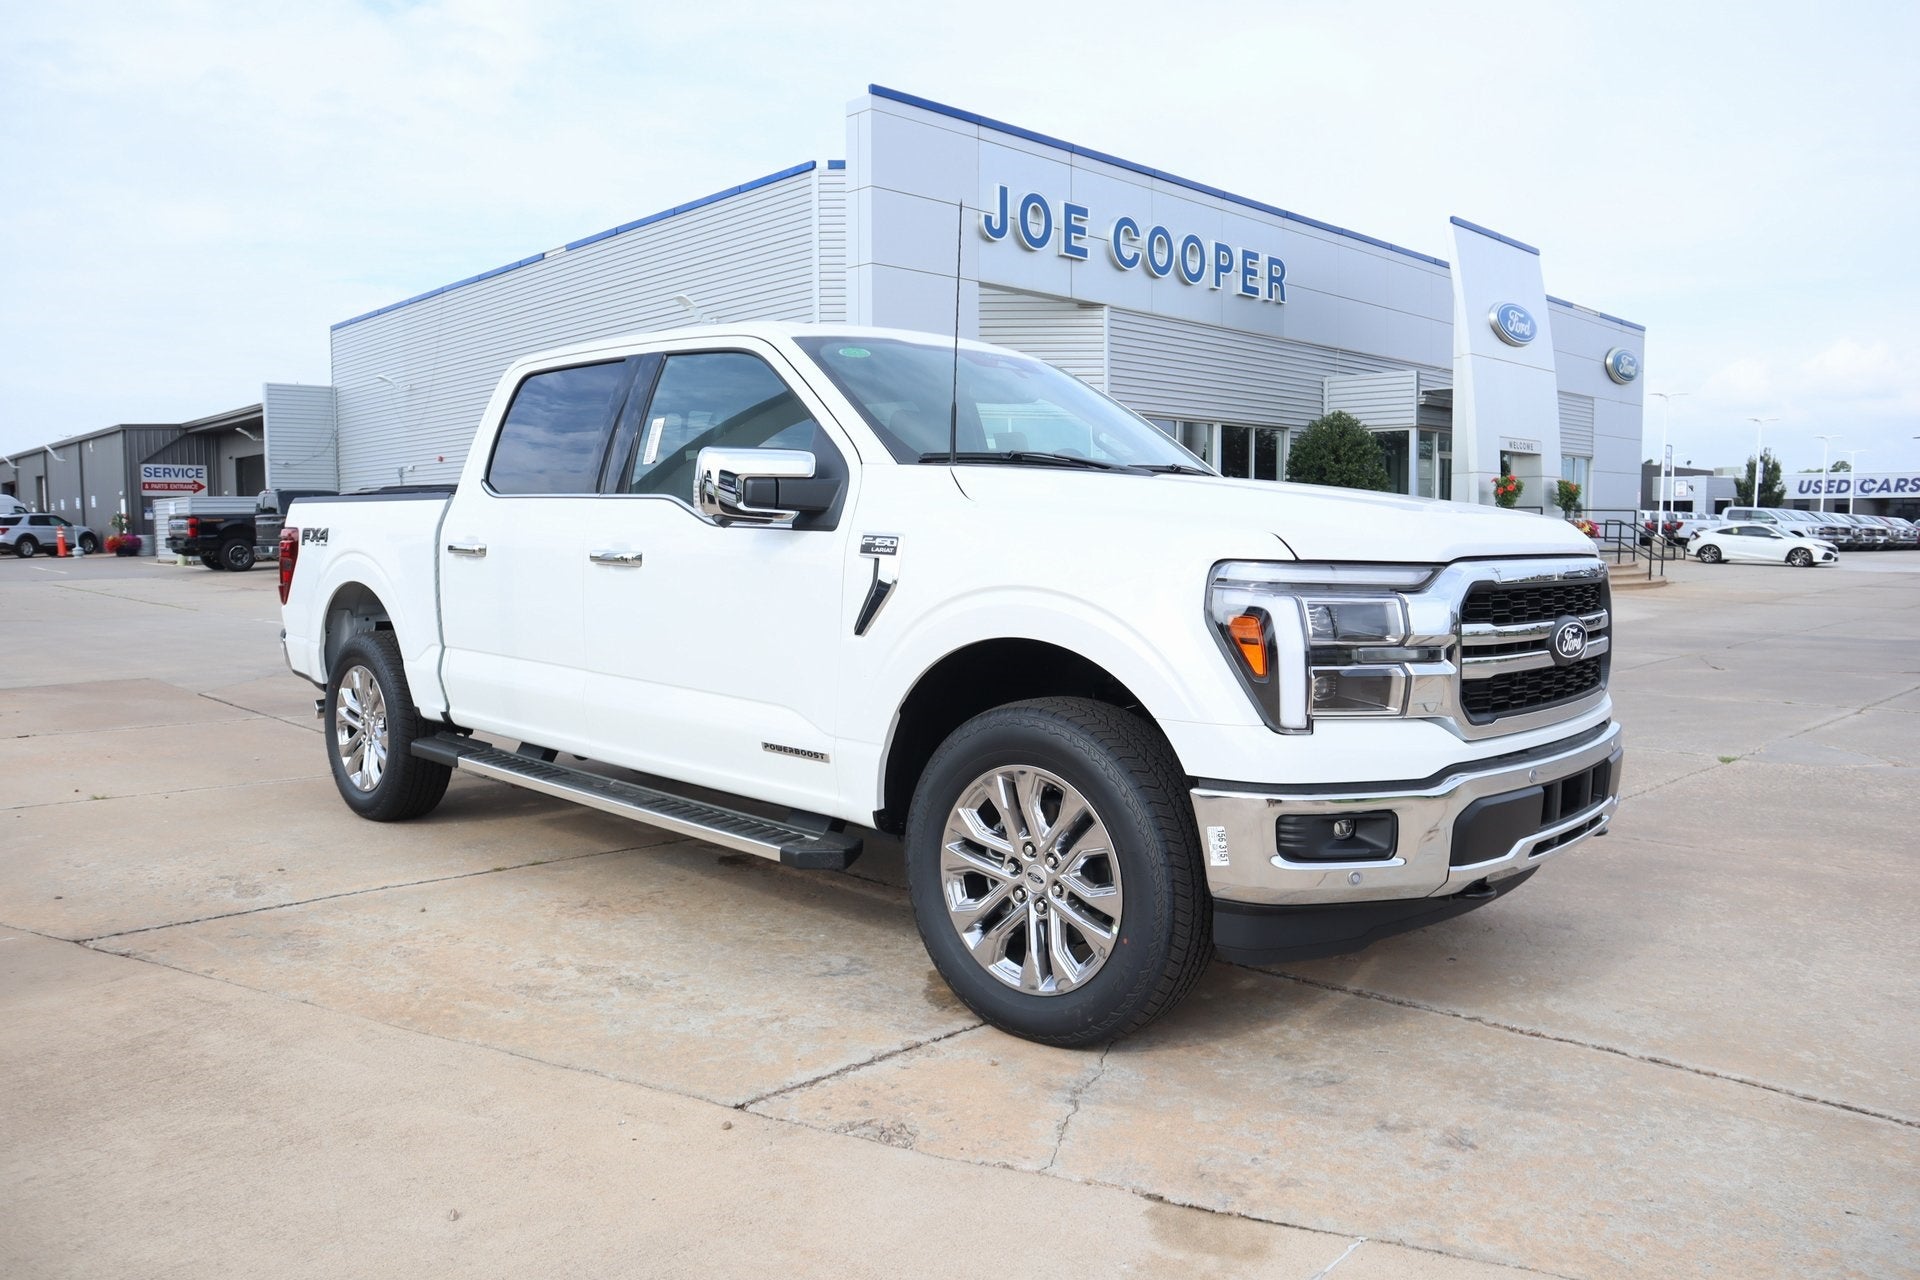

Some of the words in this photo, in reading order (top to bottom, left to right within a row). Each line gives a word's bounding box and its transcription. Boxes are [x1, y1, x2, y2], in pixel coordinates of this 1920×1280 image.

[979, 183, 1090, 261] JOE
[1109, 215, 1287, 304] COOPER
[1507, 309, 1531, 336] Ford
[1508, 441, 1534, 451] WELCOME
[143, 466, 204, 479] SERVICE
[1798, 479, 1852, 494] USED
[1859, 477, 1920, 493] CARS
[301, 527, 329, 546] FX4
[1562, 626, 1583, 653] Ford
[763, 742, 825, 760] POWERBOOST
[1218, 844, 1229, 862] 3151
